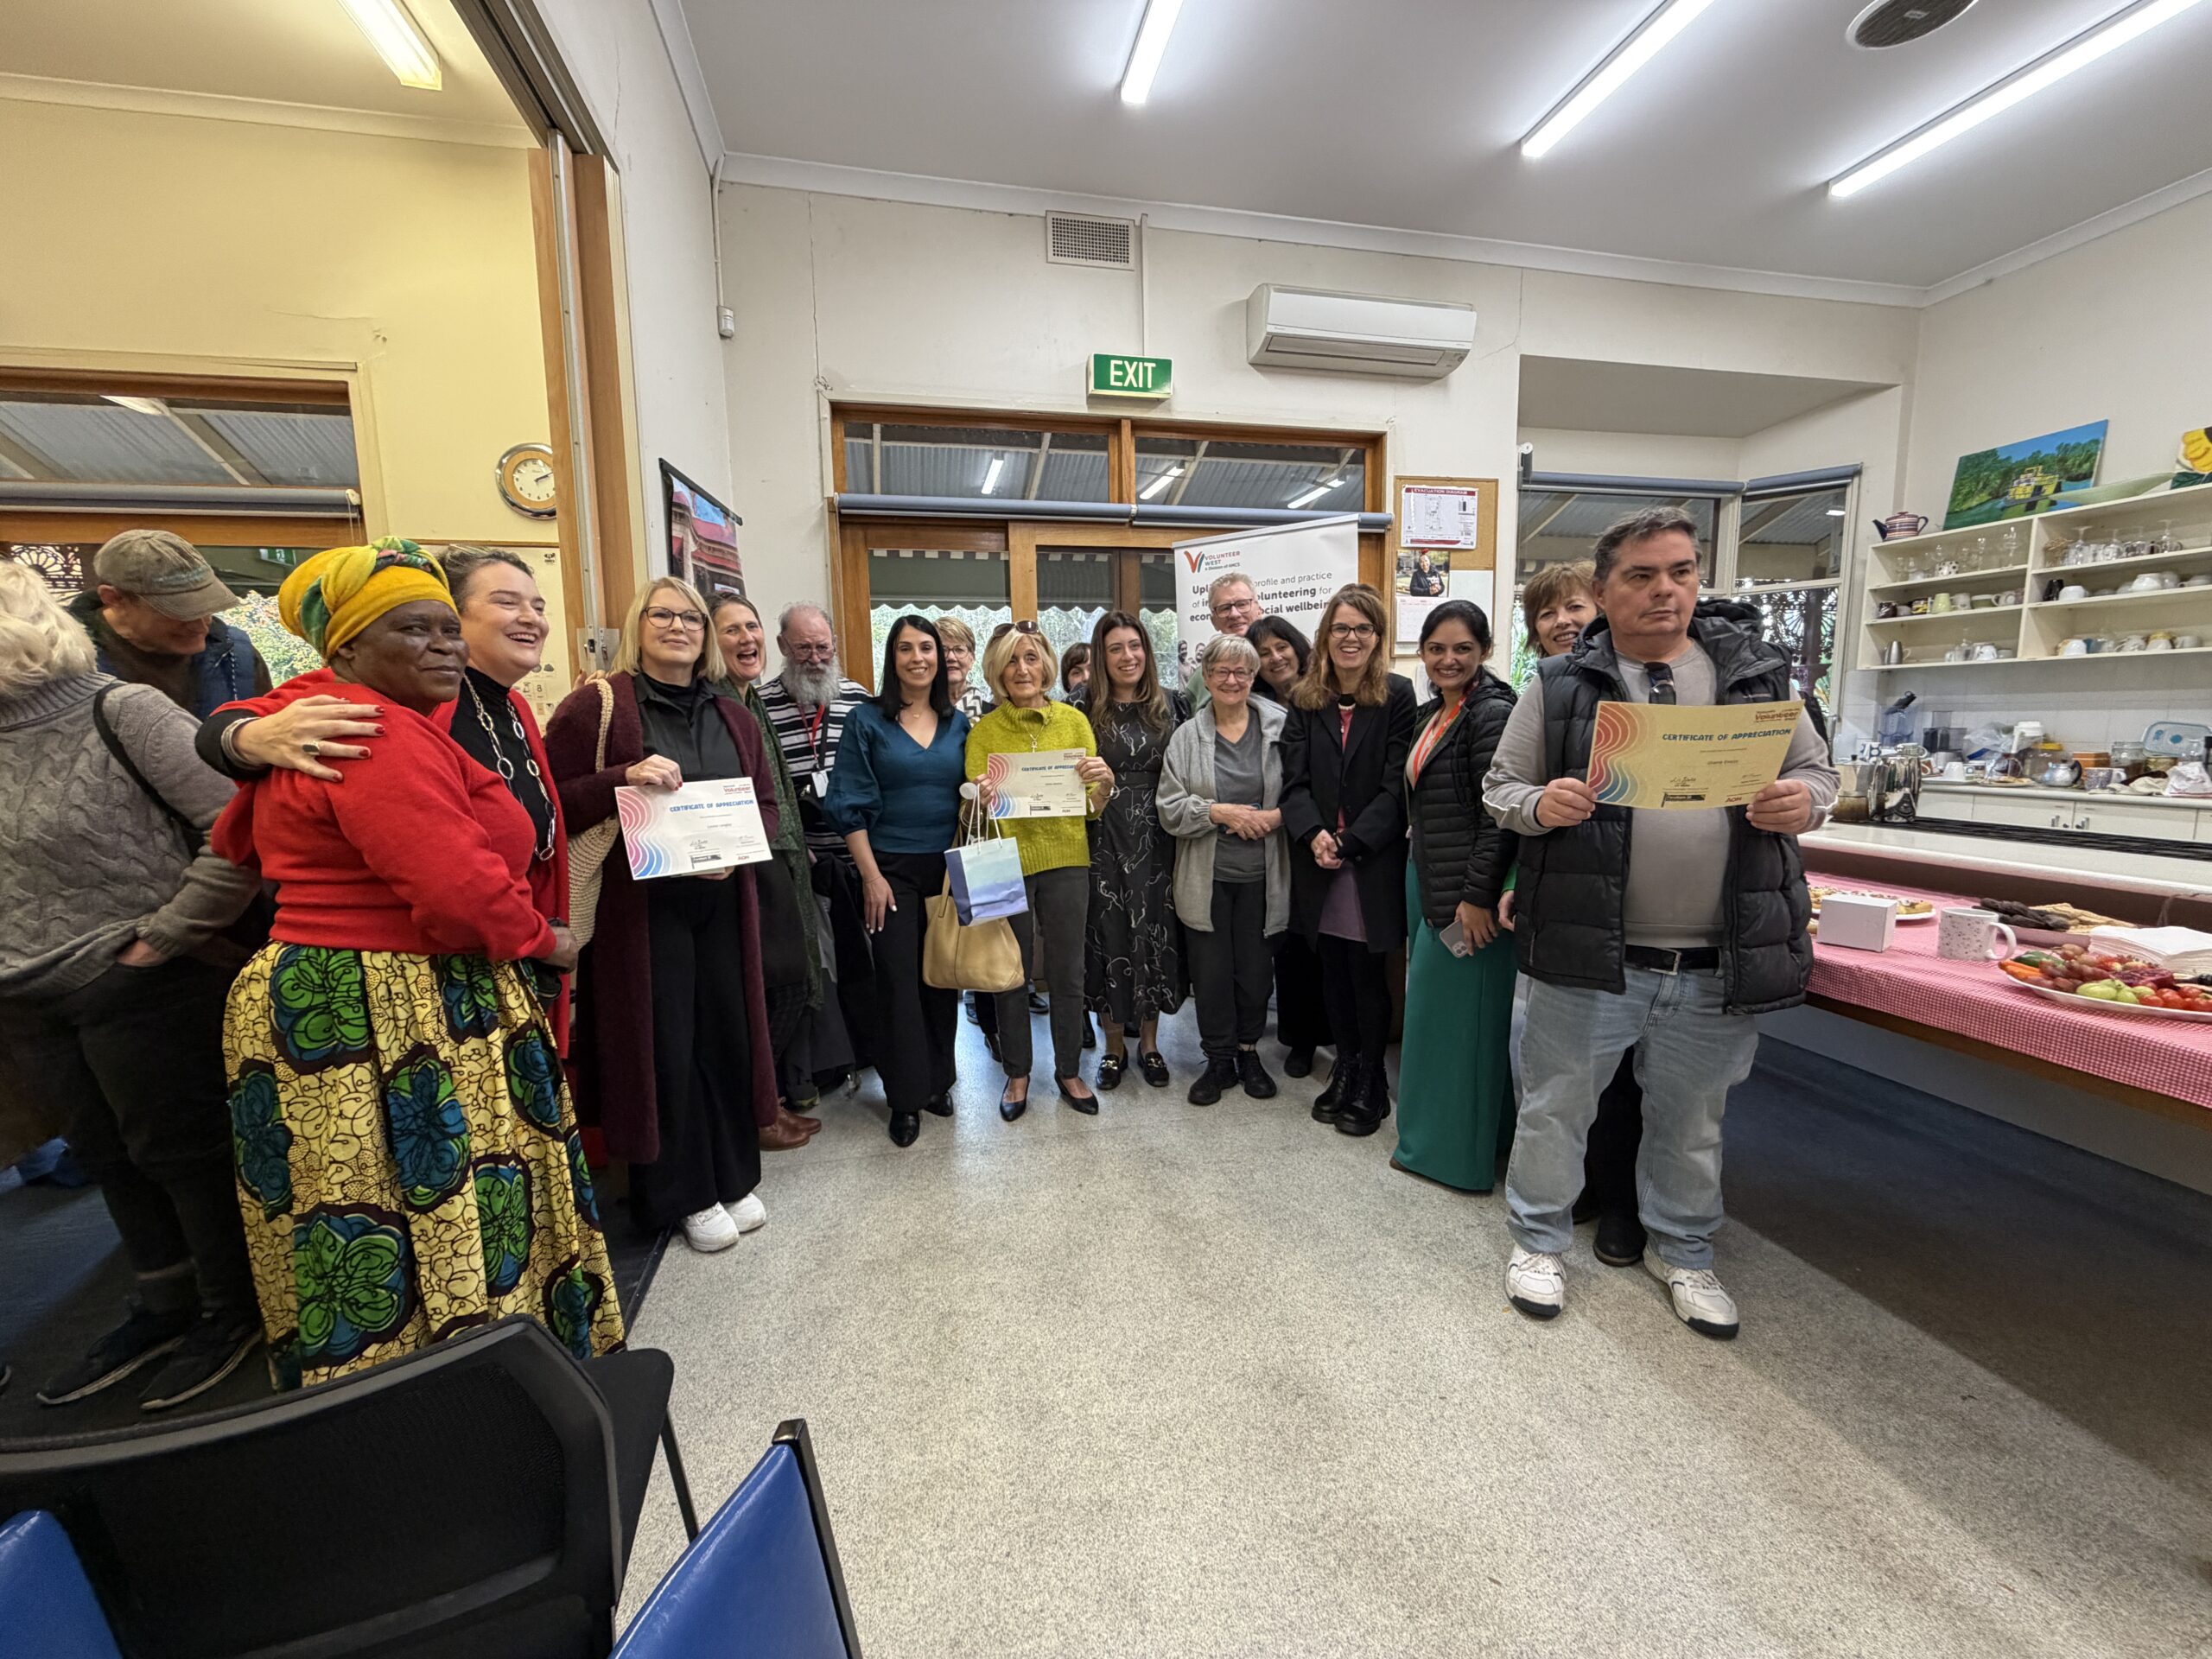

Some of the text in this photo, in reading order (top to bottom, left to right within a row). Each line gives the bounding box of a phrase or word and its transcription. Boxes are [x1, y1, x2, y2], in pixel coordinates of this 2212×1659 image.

[1109, 359, 1156, 388] EXIT
[1205, 550, 1241, 561] VOLUNTEER
[1192, 584, 1211, 595] Upl
[1281, 575, 1296, 585] and
[1298, 571, 1332, 584] practice
[1192, 600, 1200, 608] of
[1262, 604, 1283, 614] ocial
[1286, 600, 1329, 613] wellbein
[1662, 733, 1713, 741] CERTIFICATE
[1731, 728, 1791, 740] APPRECIATION
[670, 804, 704, 812] CERTIFICATE
[715, 800, 754, 809] APPRECIATION
